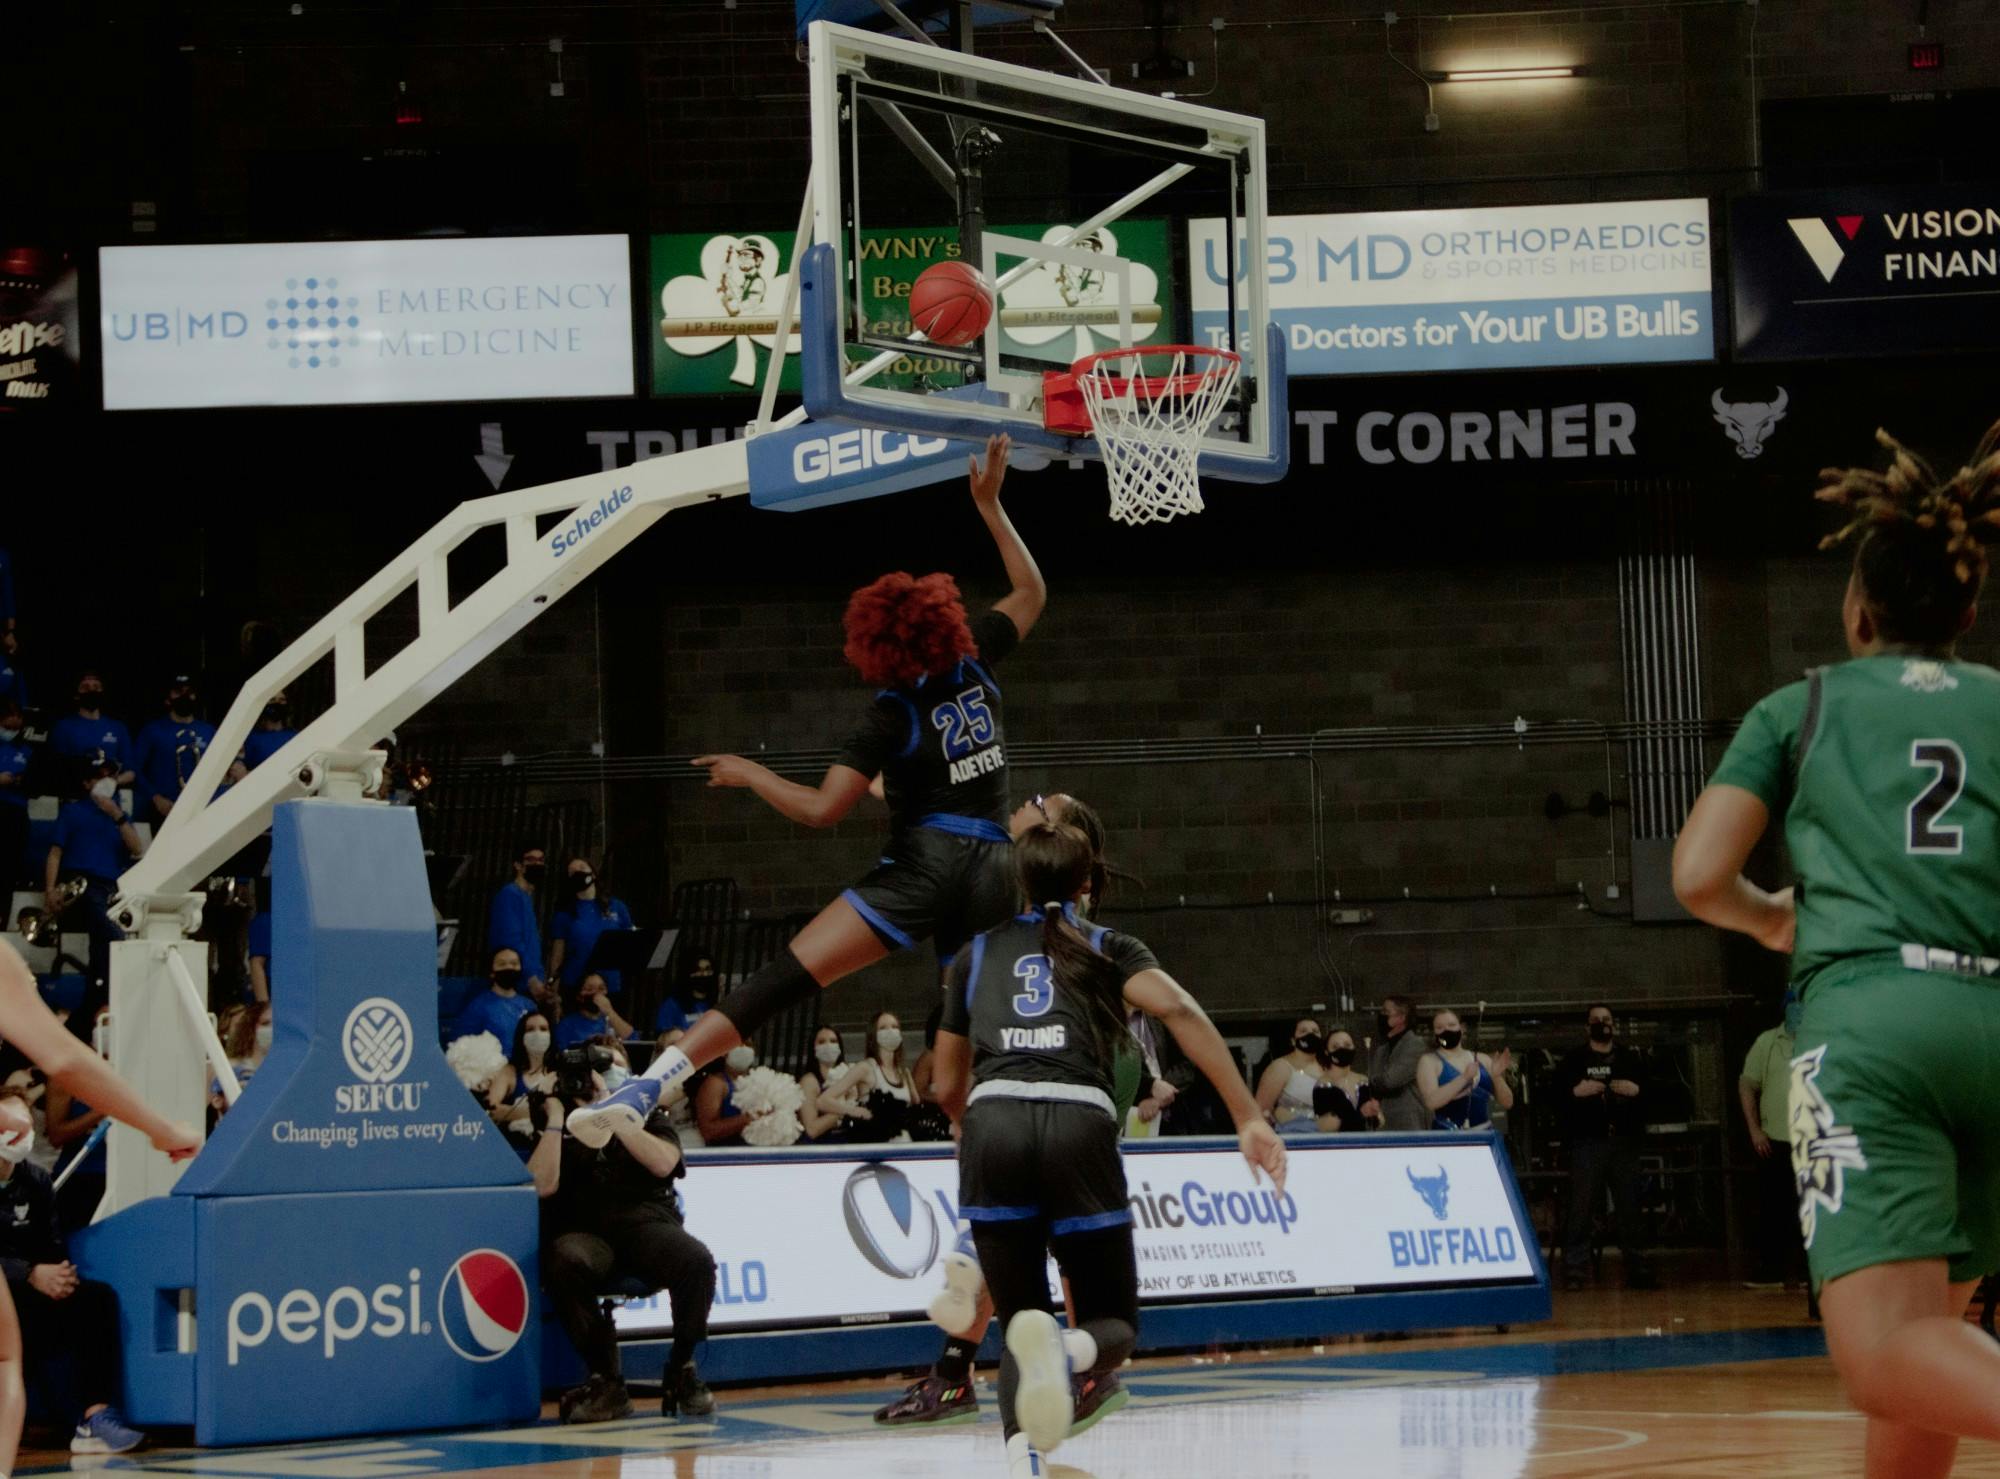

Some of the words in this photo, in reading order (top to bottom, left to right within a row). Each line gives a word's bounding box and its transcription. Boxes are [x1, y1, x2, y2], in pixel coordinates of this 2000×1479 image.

[1421, 222, 1706, 257] ORTHOPAEDICS
[1883, 208, 2000, 240] VISION
[1205, 237, 1297, 287] UB
[1317, 234, 1412, 282] MD
[1446, 257, 1557, 279] SPORTS
[1570, 251, 1706, 274] MEDICINE
[377, 283, 617, 314] EMERGENCY
[378, 327, 582, 358] MEDICINE
[1291, 319, 1407, 350] Doctors
[1413, 317, 1458, 346] for
[1460, 309, 1548, 344] Your
[1555, 305, 1609, 341] UB
[1616, 299, 1700, 338] Bulls
[1356, 401, 1637, 464] CORNER
[551, 485, 633, 558] Schelde
[931, 685, 995, 761] 25
[1906, 738, 1967, 855] 2
[1013, 954, 1054, 1017] 3
[1000, 1024, 1065, 1050] YOUNG
[335, 1082, 421, 1113] SEFCU
[272, 1121, 358, 1149] Changing
[362, 1118, 399, 1140] lives
[403, 1121, 448, 1144] every
[452, 1114, 485, 1140] day.
[1388, 1226, 1516, 1268] BUFFALO
[1177, 1275, 1195, 1289] OF
[1200, 1273, 1219, 1288] UB
[1224, 1270, 1297, 1287] ATHLETICS
[227, 1267, 421, 1366] pepsi
